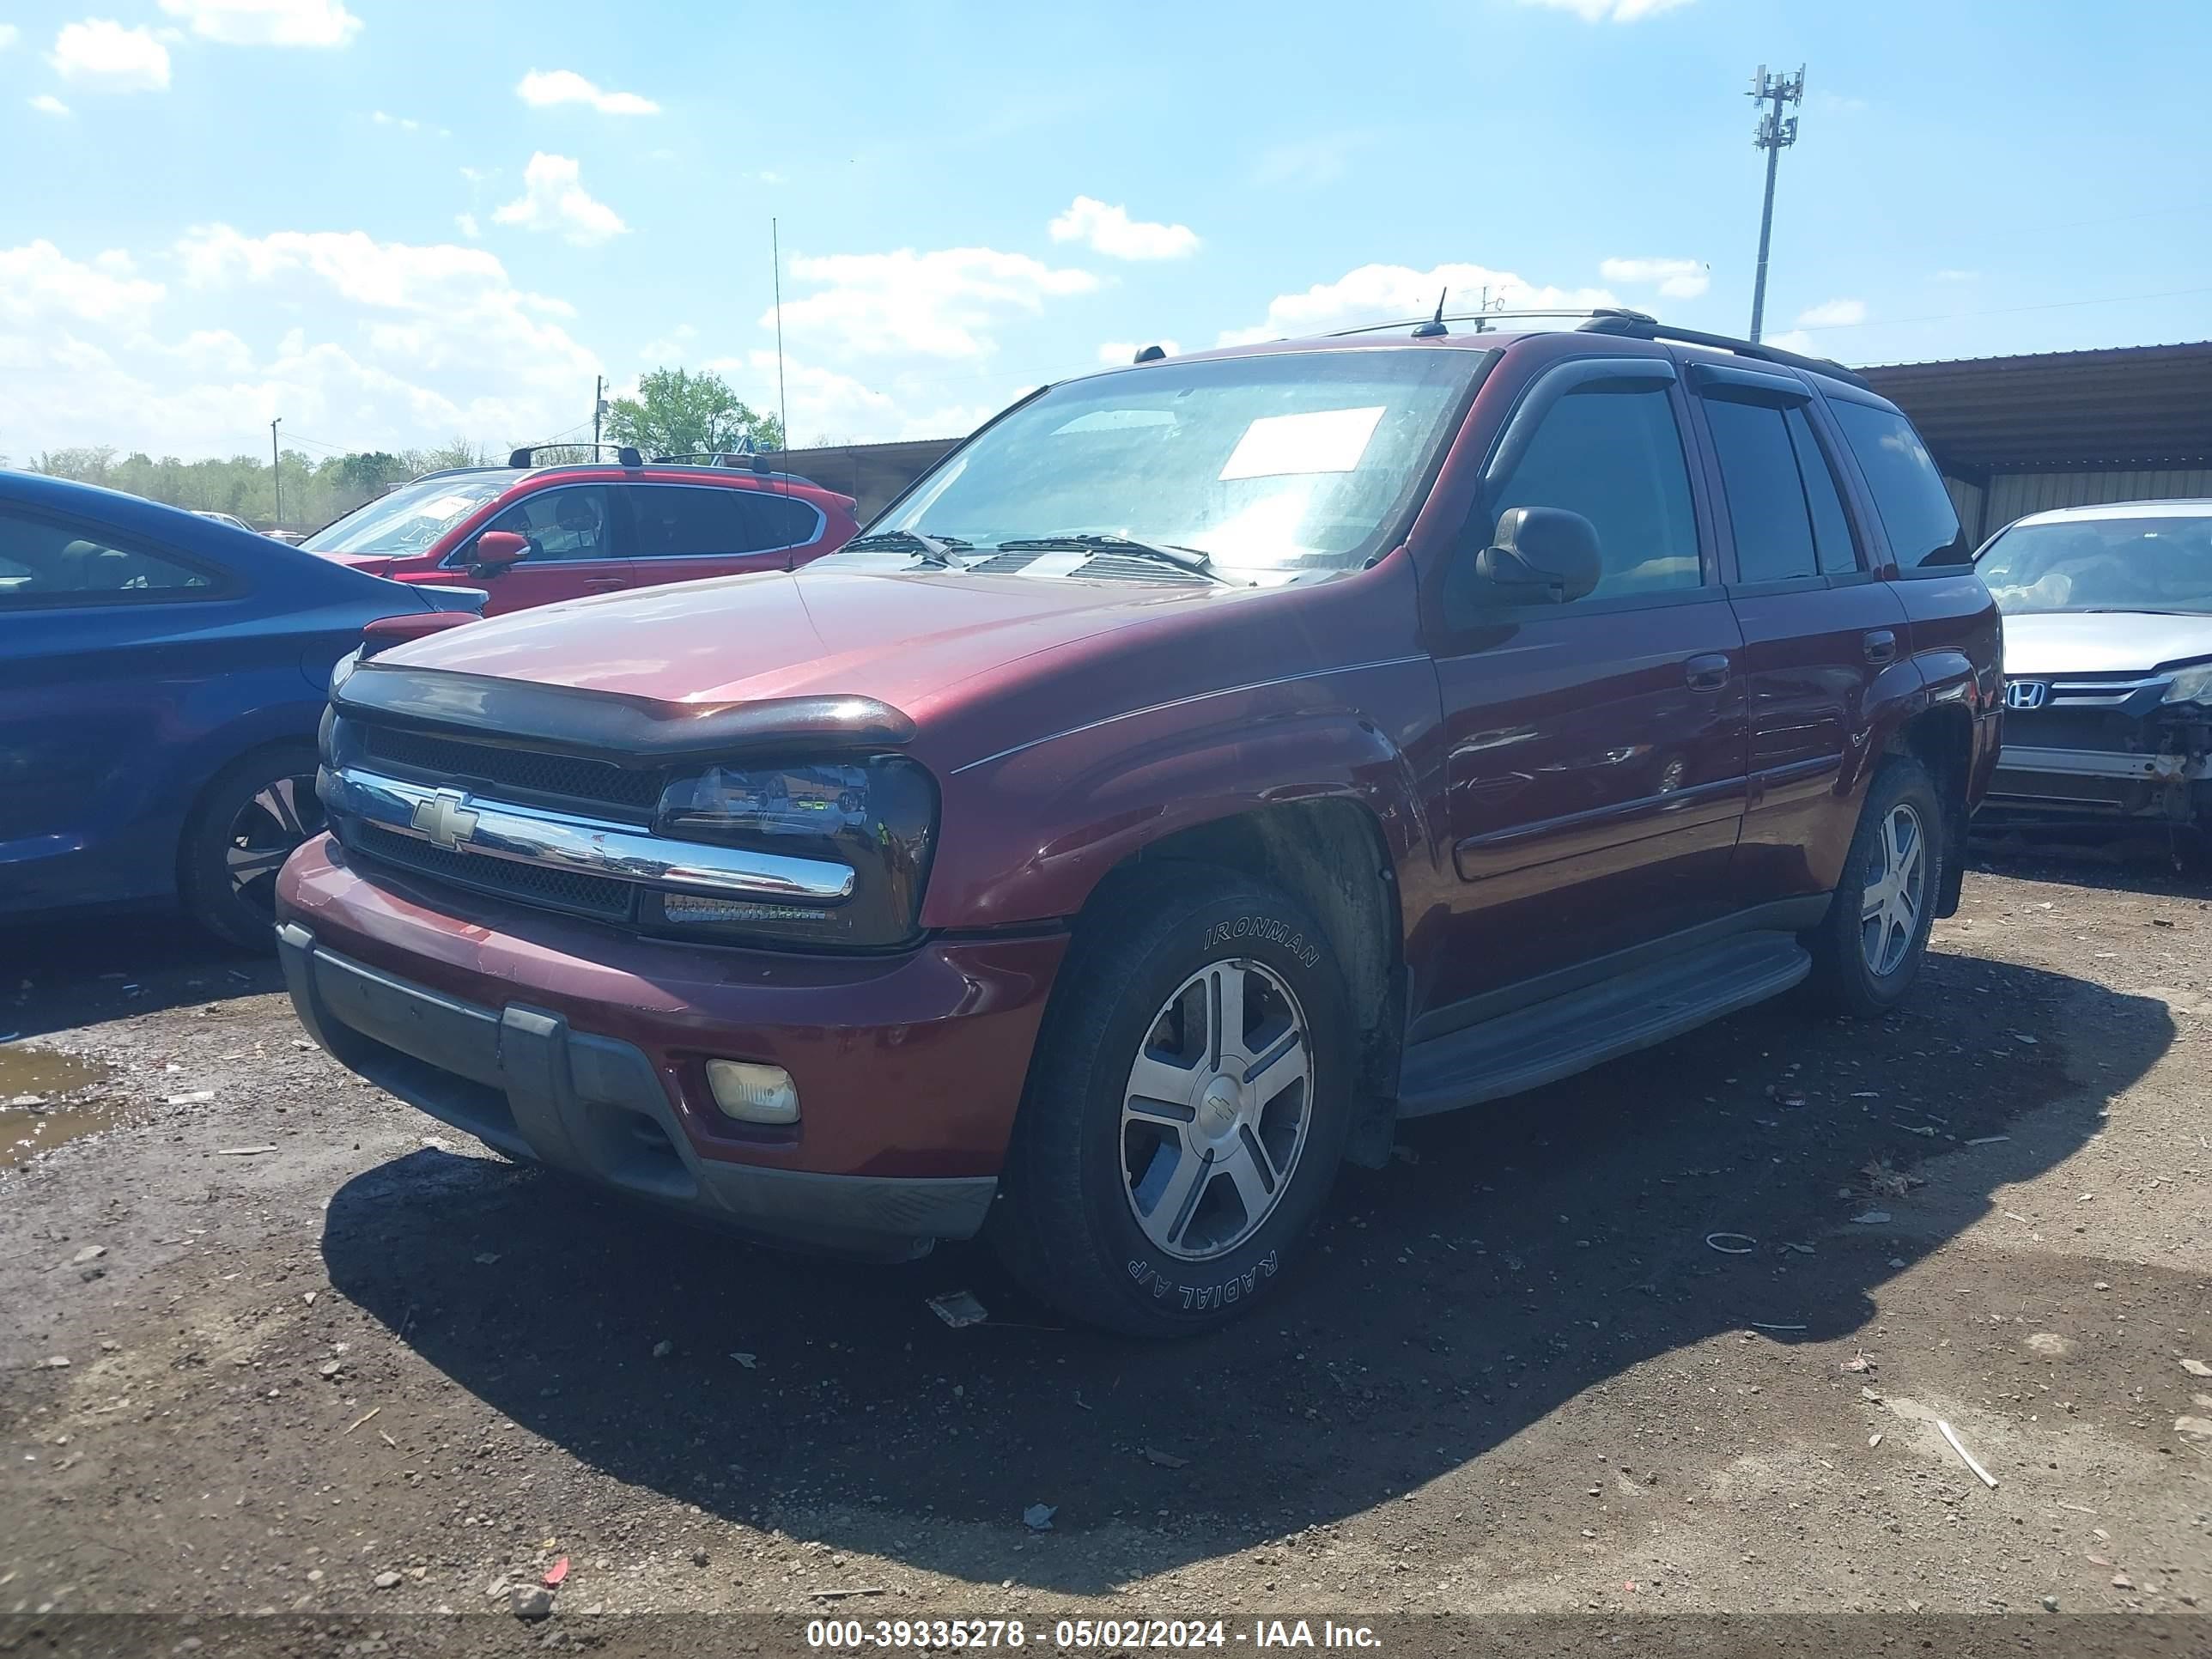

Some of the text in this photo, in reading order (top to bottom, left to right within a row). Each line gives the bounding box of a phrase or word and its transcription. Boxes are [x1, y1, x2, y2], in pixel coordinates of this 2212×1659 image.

[1203, 915, 1320, 969] IRONMAN
[1127, 1249, 1279, 1310] RADIAL A/P
